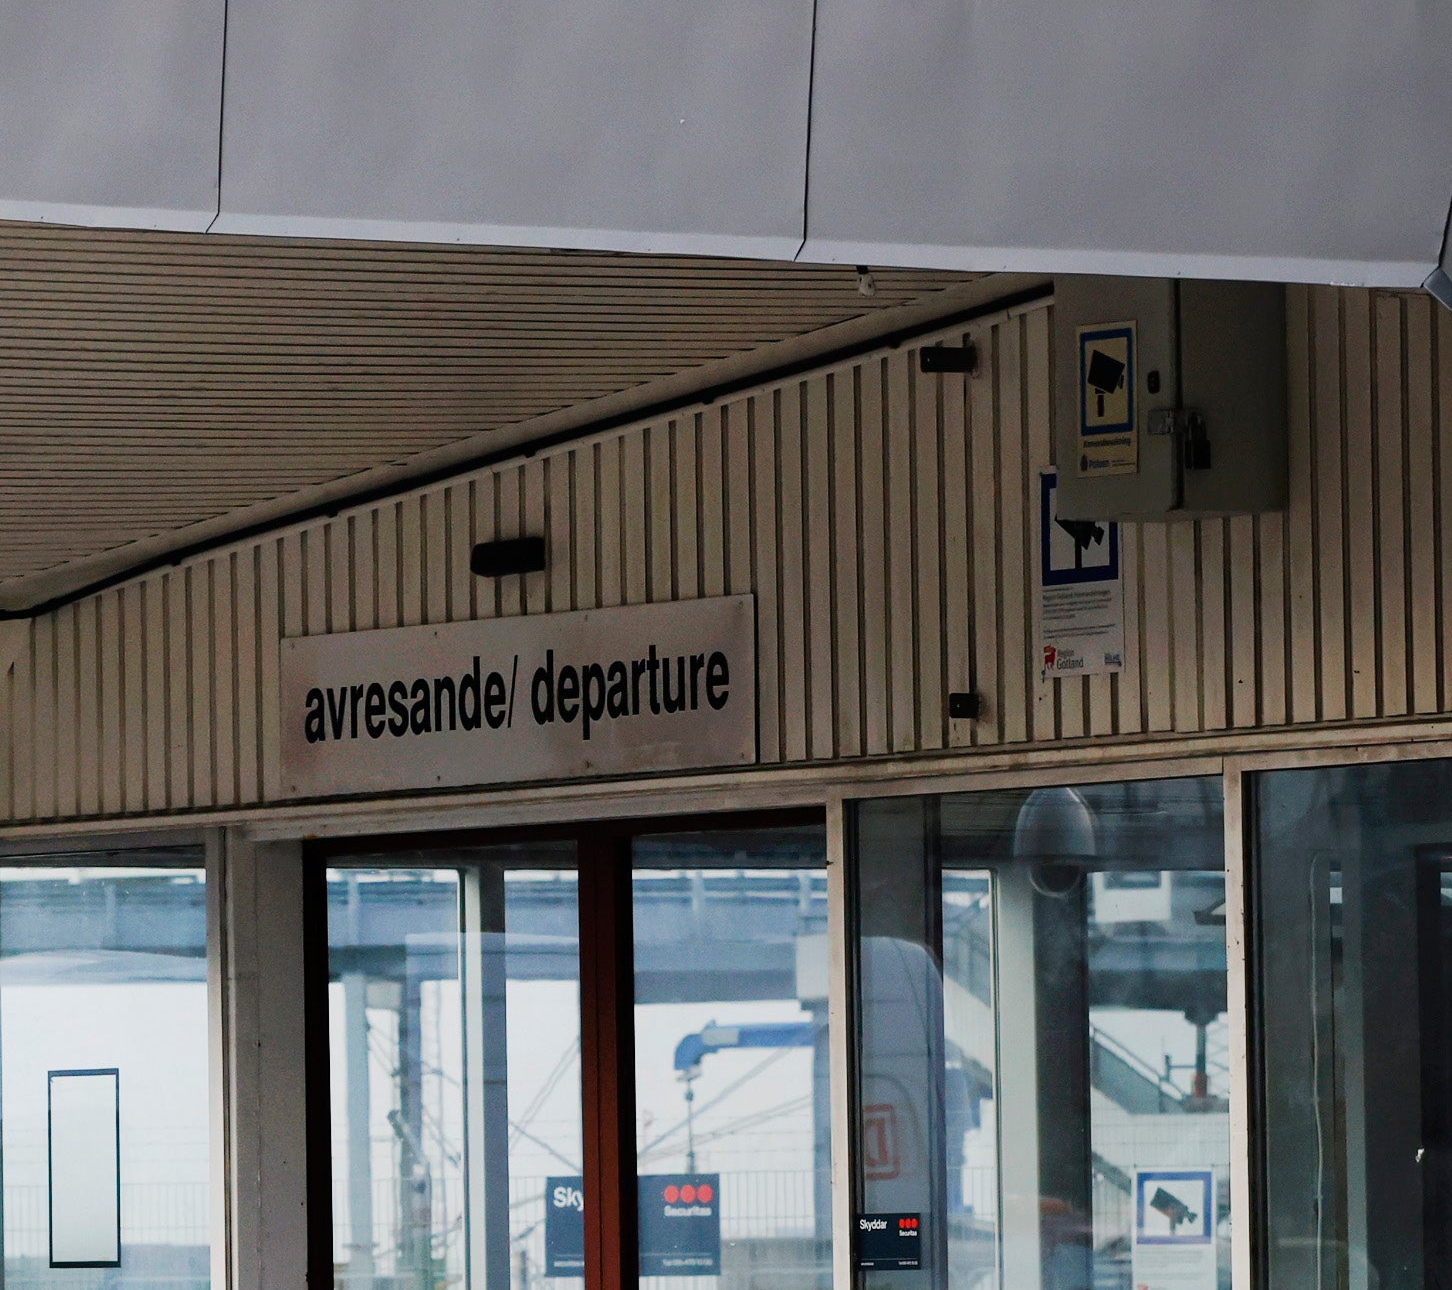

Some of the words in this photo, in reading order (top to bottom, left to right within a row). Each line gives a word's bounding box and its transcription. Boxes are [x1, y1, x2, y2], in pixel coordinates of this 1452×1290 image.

[304, 654, 519, 743] avresande/
[531, 644, 730, 740] departure
[859, 1218, 888, 1232] Skyddar
